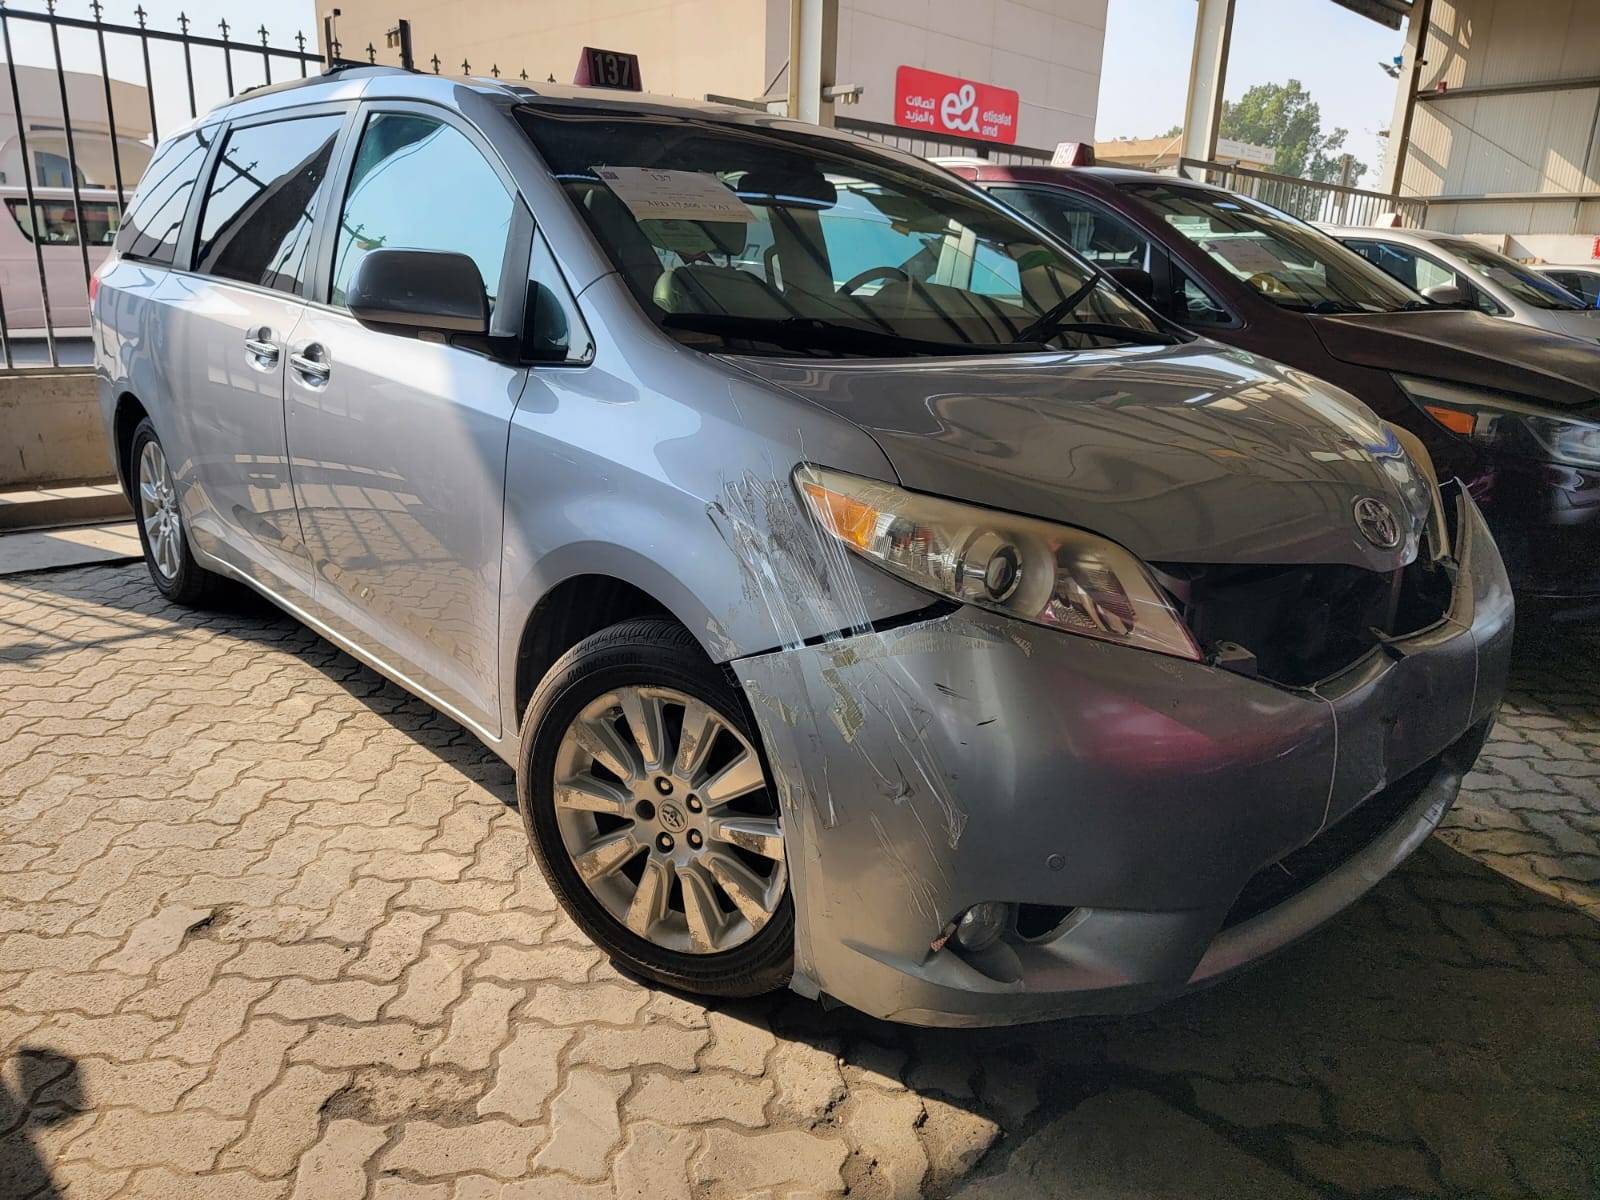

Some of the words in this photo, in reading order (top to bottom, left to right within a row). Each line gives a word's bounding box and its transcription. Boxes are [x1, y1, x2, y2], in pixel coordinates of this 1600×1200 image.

[594, 53, 630, 86] 137
[983, 110, 1012, 127] etisalat
[982, 125, 998, 137] and
[650, 174, 672, 182] 137
